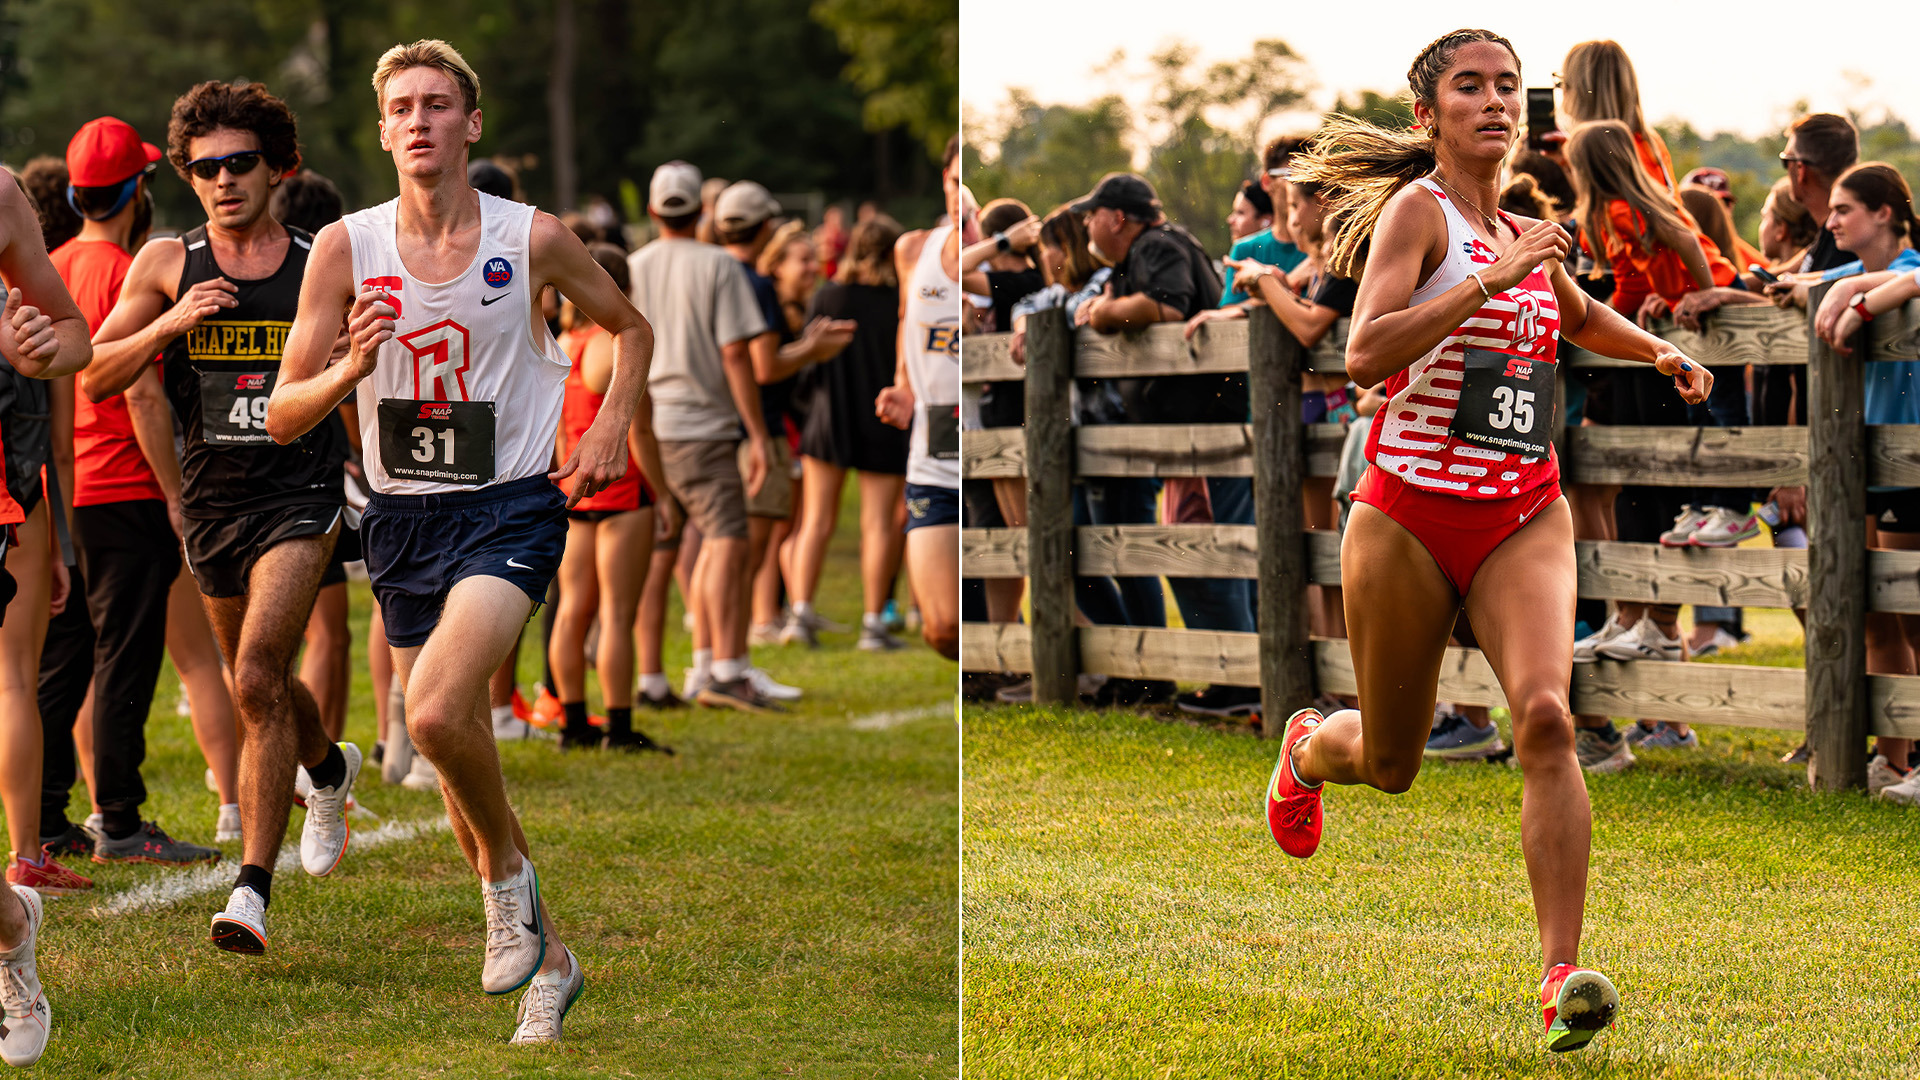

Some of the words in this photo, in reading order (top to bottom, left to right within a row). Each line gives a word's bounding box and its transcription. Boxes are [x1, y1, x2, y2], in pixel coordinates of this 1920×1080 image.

[487, 271, 510, 282] 250
[489, 261, 506, 272] VA
[1510, 289, 1540, 345] R
[187, 325, 260, 355] CHAPEL
[265, 326, 291, 355] HI
[396, 318, 470, 401] R
[1502, 358, 1533, 377] SNAP
[234, 374, 266, 389] SNAP
[229, 396, 270, 429] 49
[417, 403, 453, 419] SNAP
[1488, 386, 1535, 434] 35
[411, 426, 455, 465] 31
[1466, 431, 1545, 453] www.snaptiming.com
[394, 467, 478, 481] www.snaptiming.com
